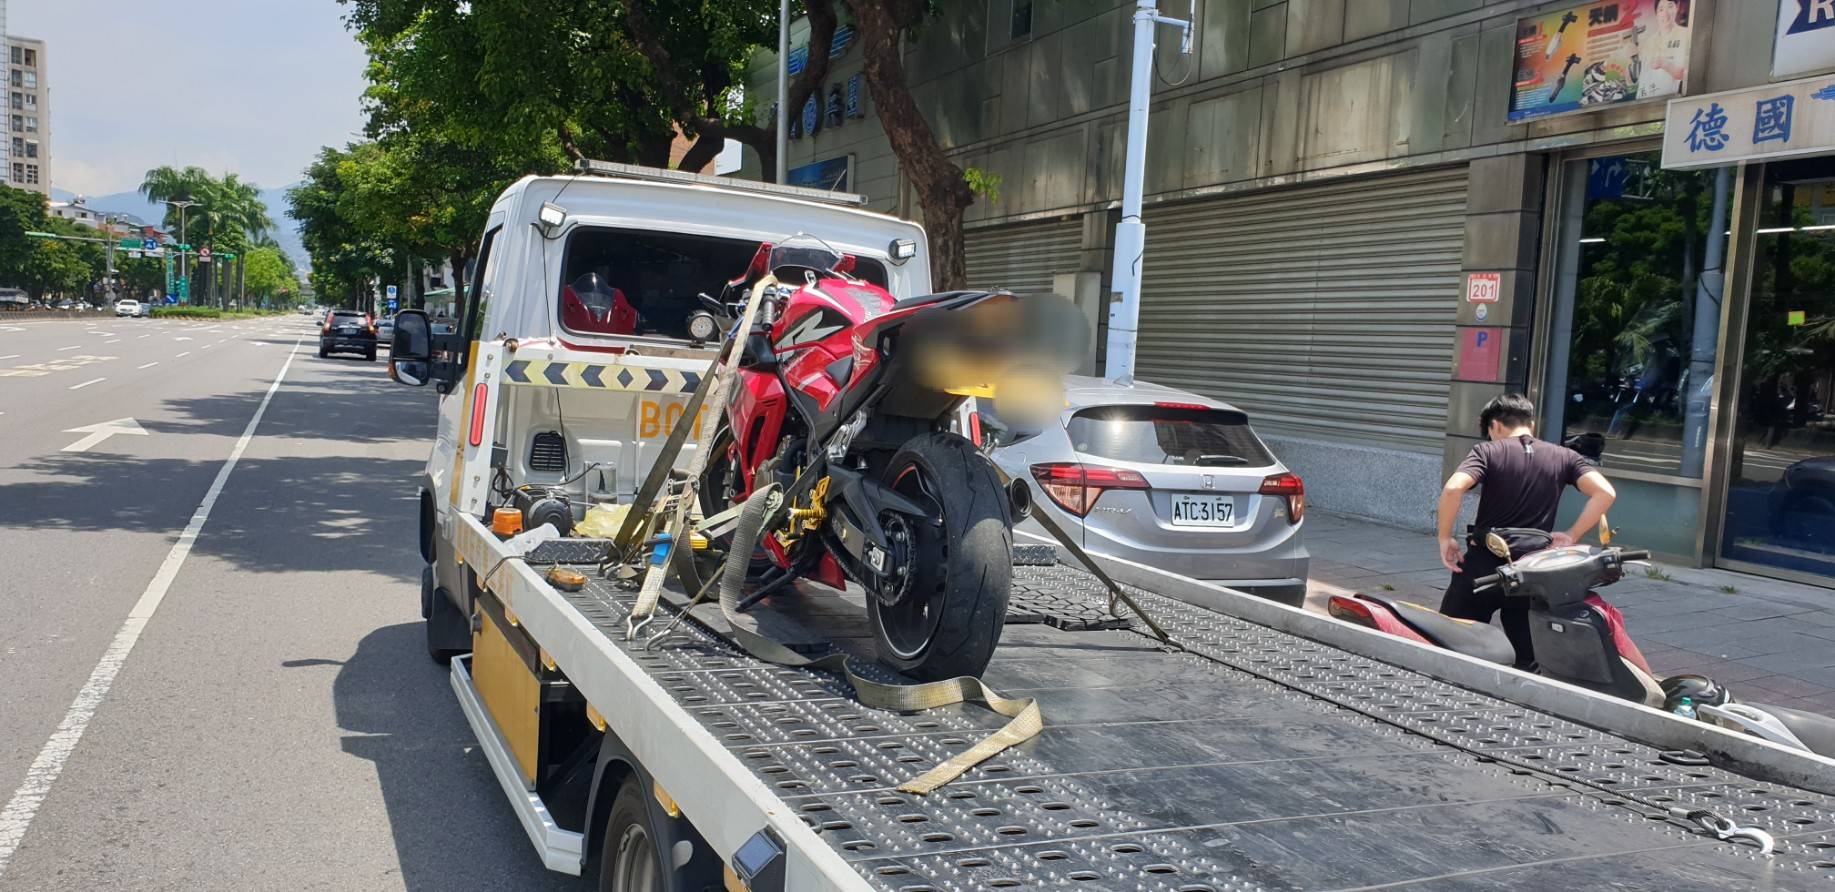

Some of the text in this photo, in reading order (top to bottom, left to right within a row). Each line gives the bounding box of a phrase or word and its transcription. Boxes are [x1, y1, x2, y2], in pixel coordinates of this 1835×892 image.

[1684, 94, 1795, 153] 德國
[1472, 283, 1495, 298] 201
[1475, 331, 1489, 348] P
